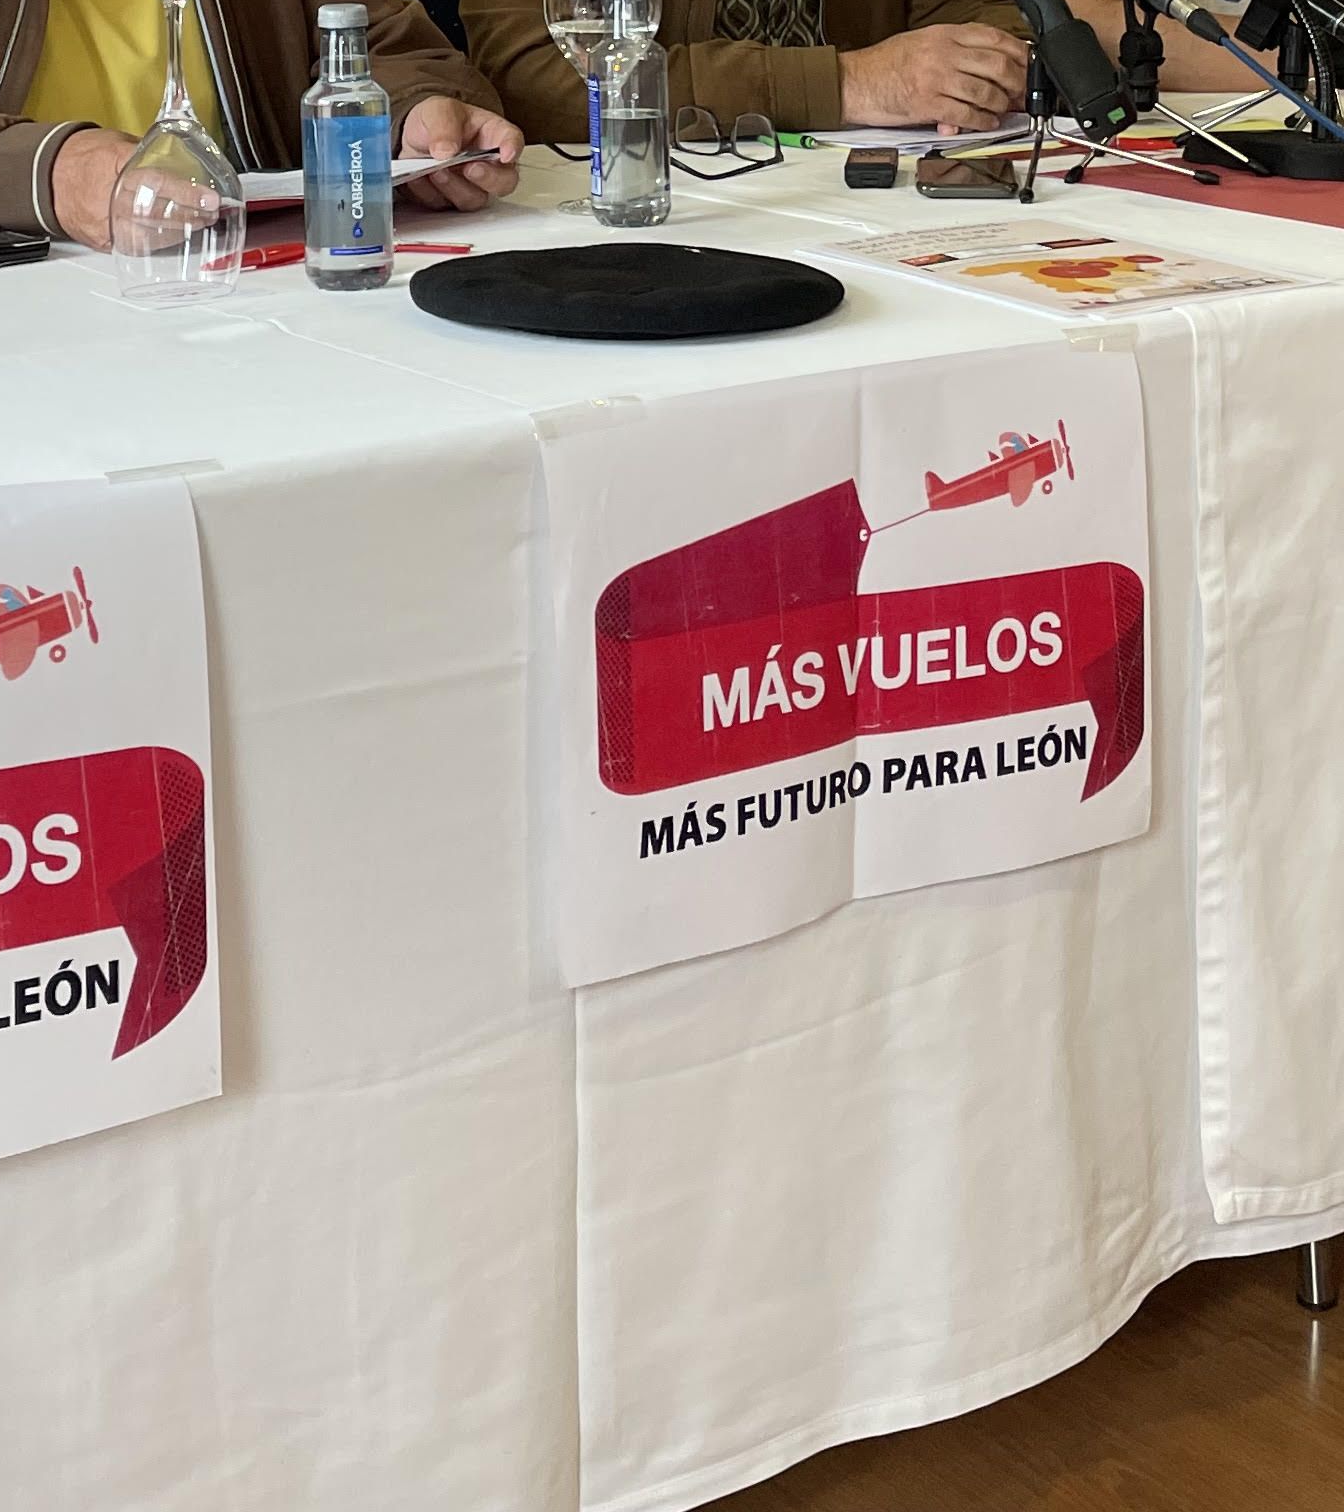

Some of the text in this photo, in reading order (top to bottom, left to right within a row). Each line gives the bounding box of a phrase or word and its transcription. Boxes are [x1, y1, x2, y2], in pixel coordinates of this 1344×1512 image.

[701, 610, 1065, 733] MÁS VUELOS
[639, 723, 1089, 859] MÁS FUTURO PARA LEÓN
